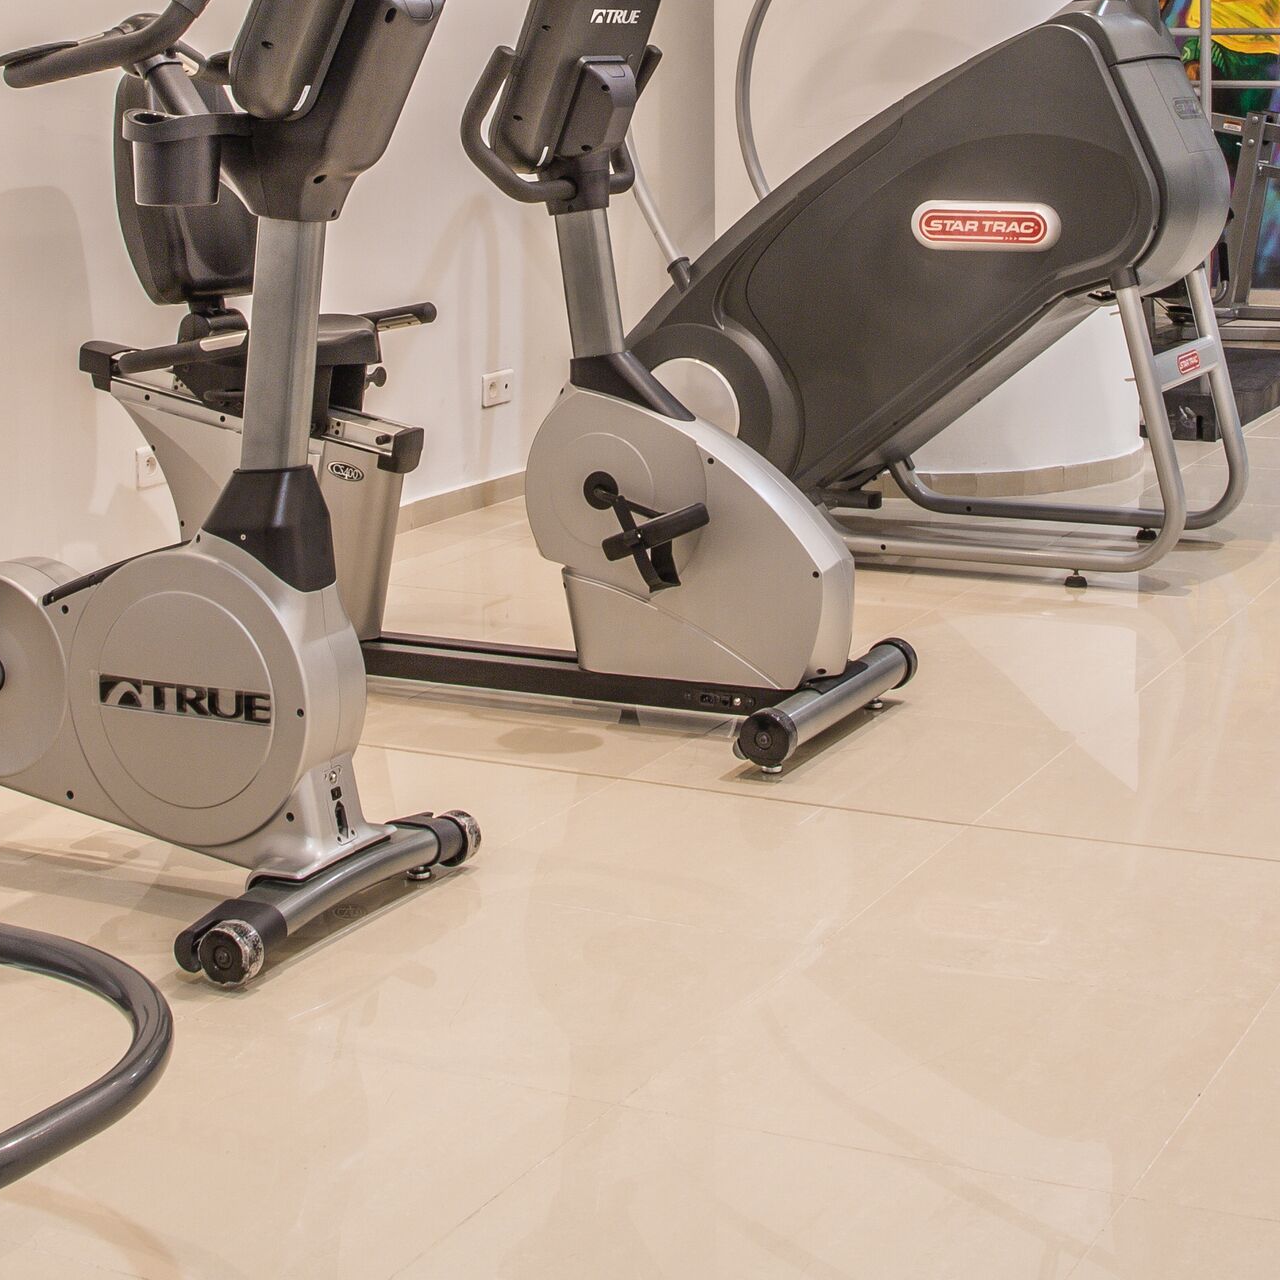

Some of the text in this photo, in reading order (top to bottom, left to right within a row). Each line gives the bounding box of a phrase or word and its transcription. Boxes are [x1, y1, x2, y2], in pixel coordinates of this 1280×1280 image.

[606, 9, 641, 24] TRUE
[928, 219, 1036, 234] STAR TRAC
[332, 464, 359, 480] CS400
[142, 679, 271, 724] TRUE
